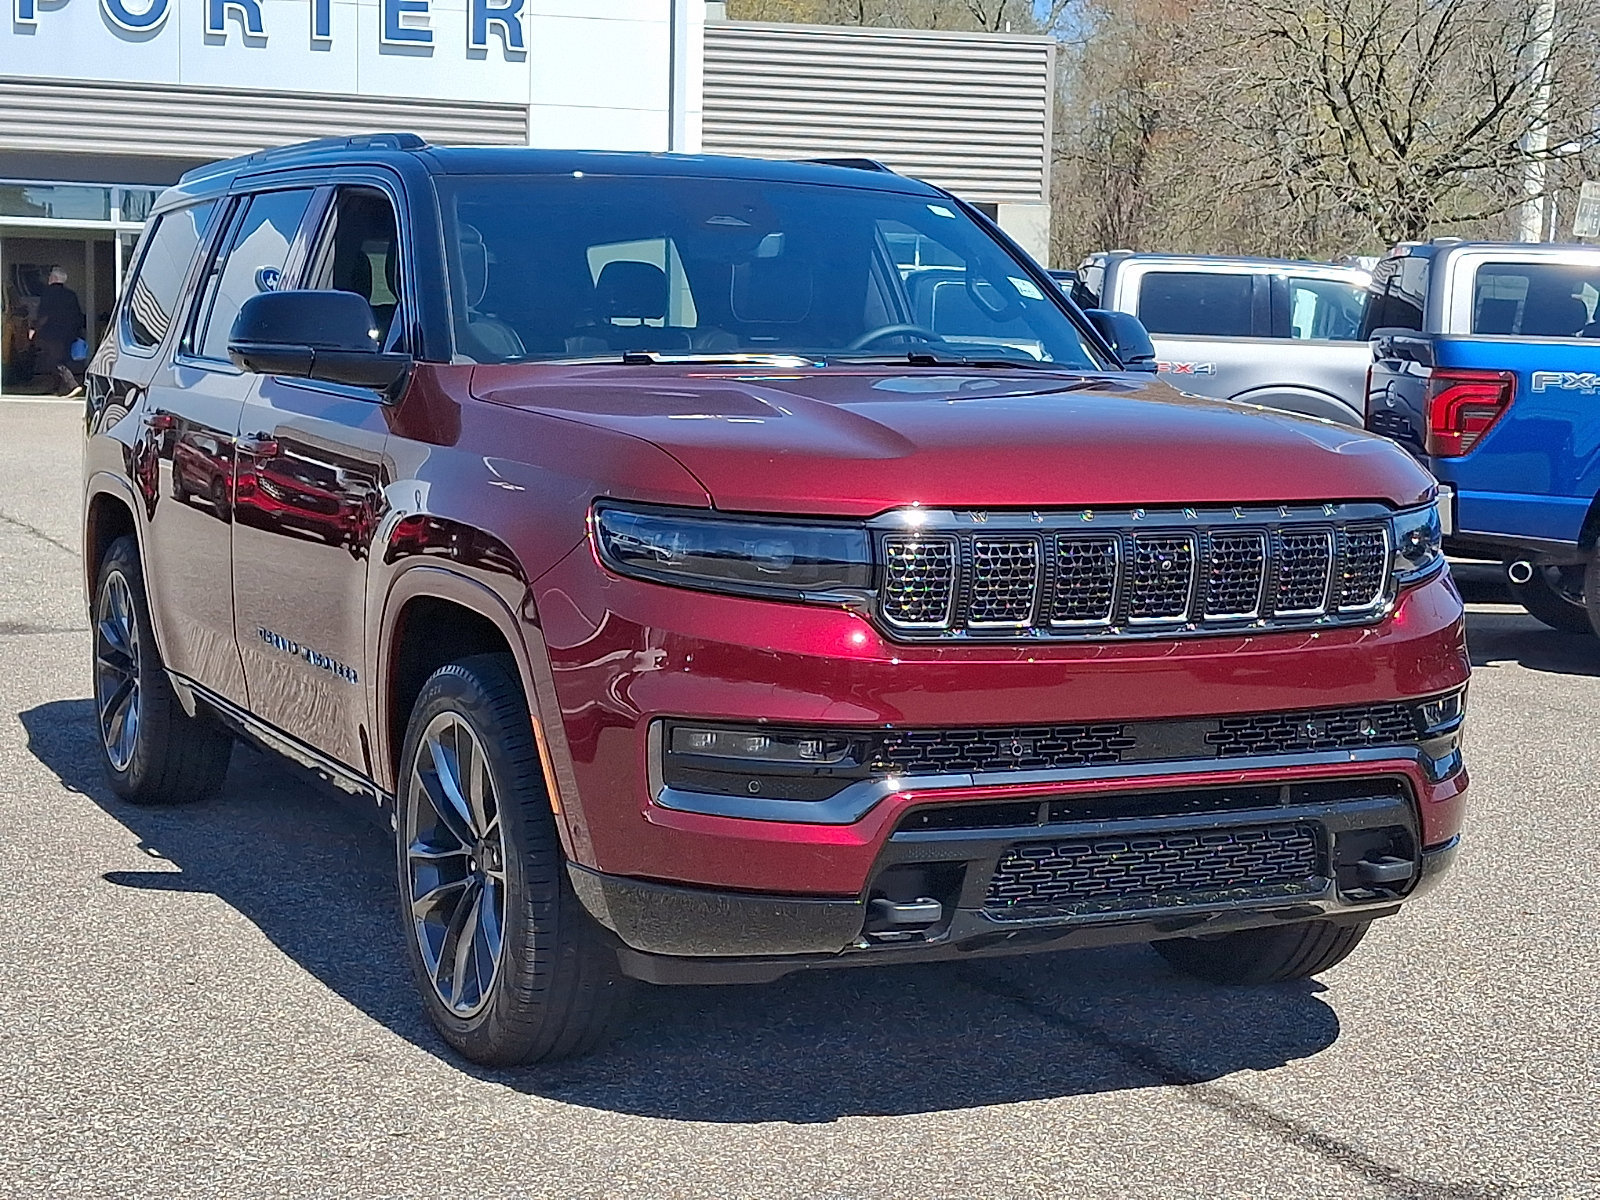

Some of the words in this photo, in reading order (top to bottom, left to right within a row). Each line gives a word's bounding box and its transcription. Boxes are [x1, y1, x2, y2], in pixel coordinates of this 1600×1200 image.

[13, 0, 528, 60] RTER
[1531, 371, 1600, 393] FX
[967, 503, 1337, 525] WAGONEER
